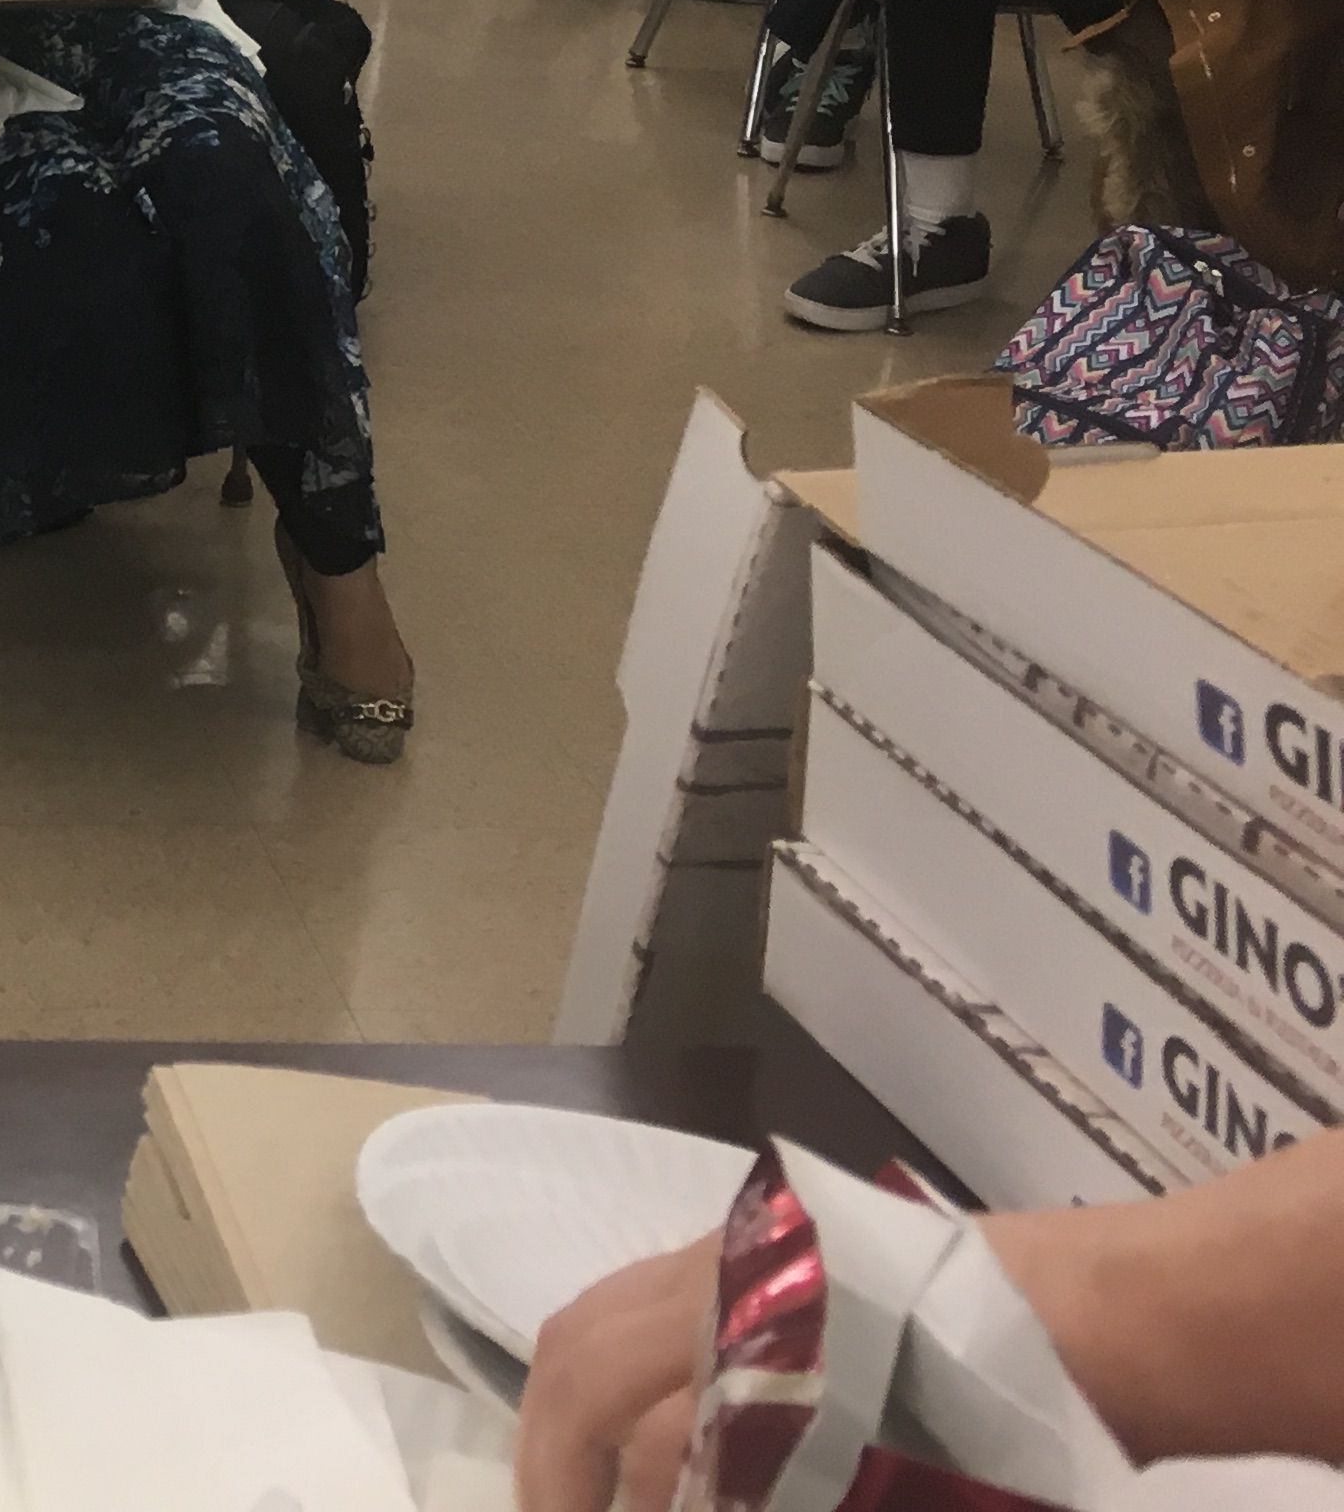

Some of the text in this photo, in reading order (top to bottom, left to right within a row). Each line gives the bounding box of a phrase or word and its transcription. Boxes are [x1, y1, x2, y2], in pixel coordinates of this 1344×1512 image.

[1264, 702, 1344, 815] GI
[1169, 856, 1344, 1031] GINO
[1162, 1034, 1298, 1162] GIN
